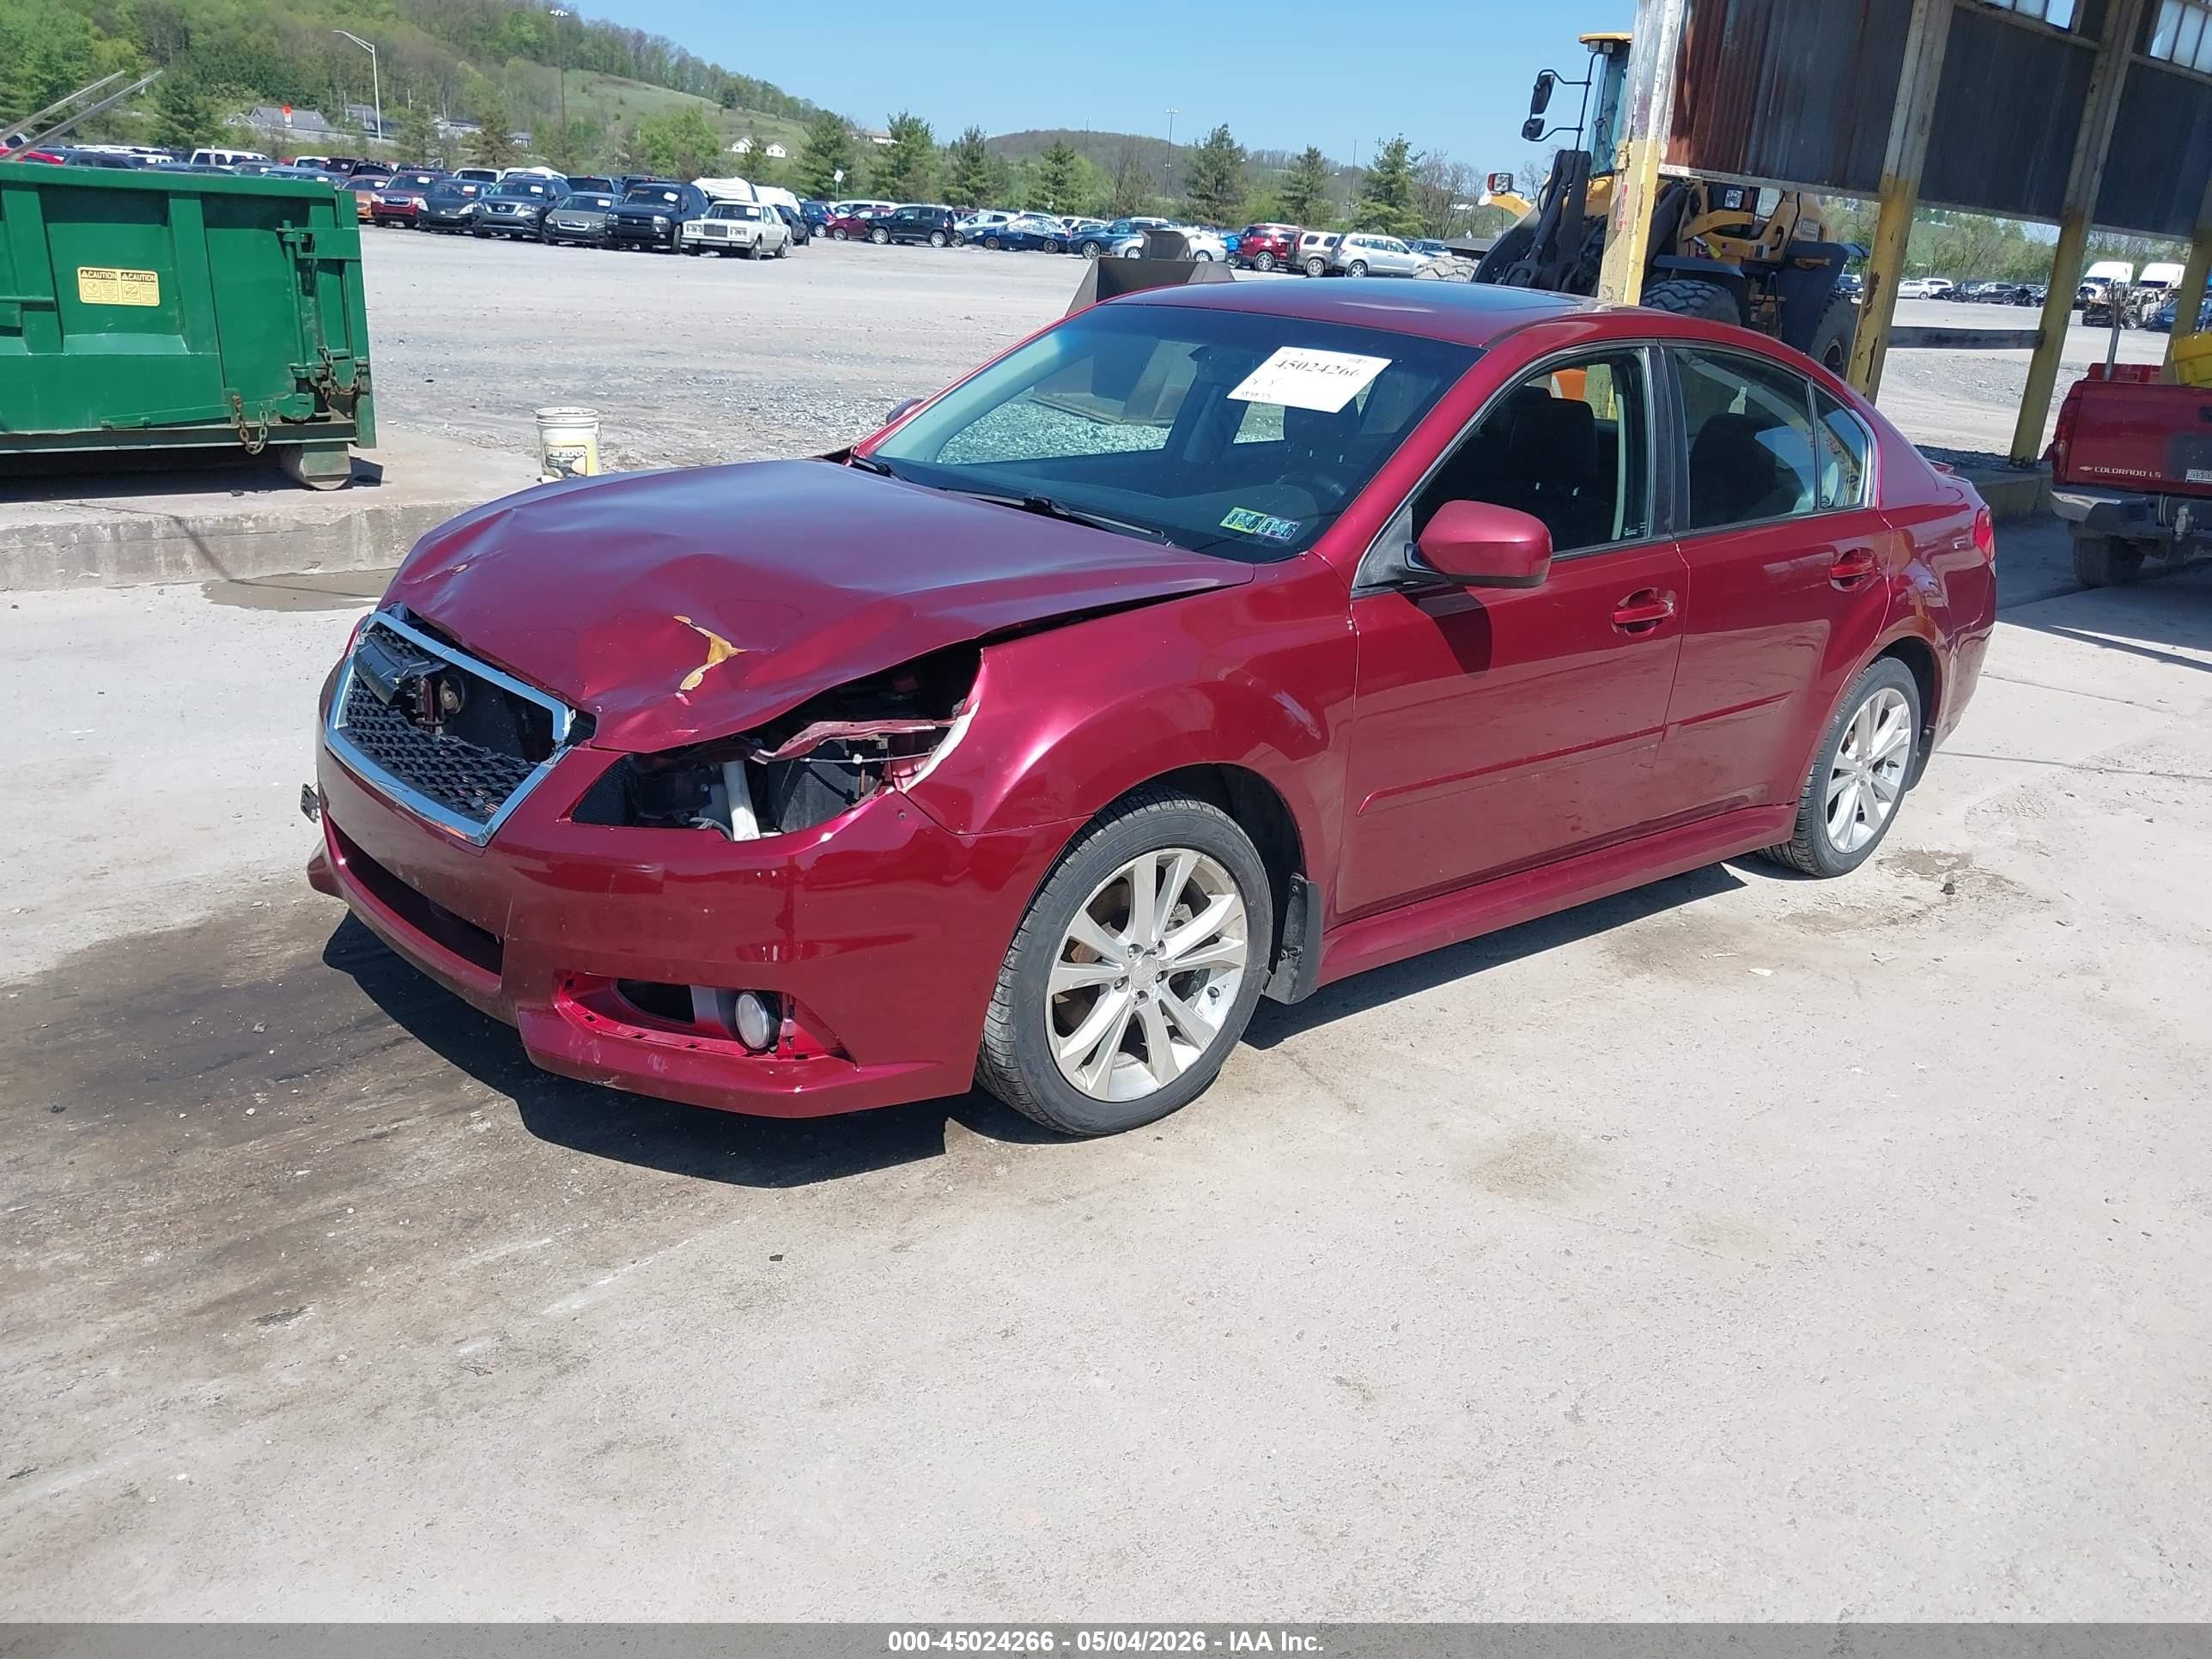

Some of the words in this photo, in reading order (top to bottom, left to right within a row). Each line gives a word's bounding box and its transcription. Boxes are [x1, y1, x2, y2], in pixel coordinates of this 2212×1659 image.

[88, 270, 117, 279] CAUTION
[128, 273, 155, 282] CAUTION
[1274, 359, 1361, 378] 45024266
[561, 448, 587, 458] 2000
[2094, 466, 2147, 477] COLORADO
